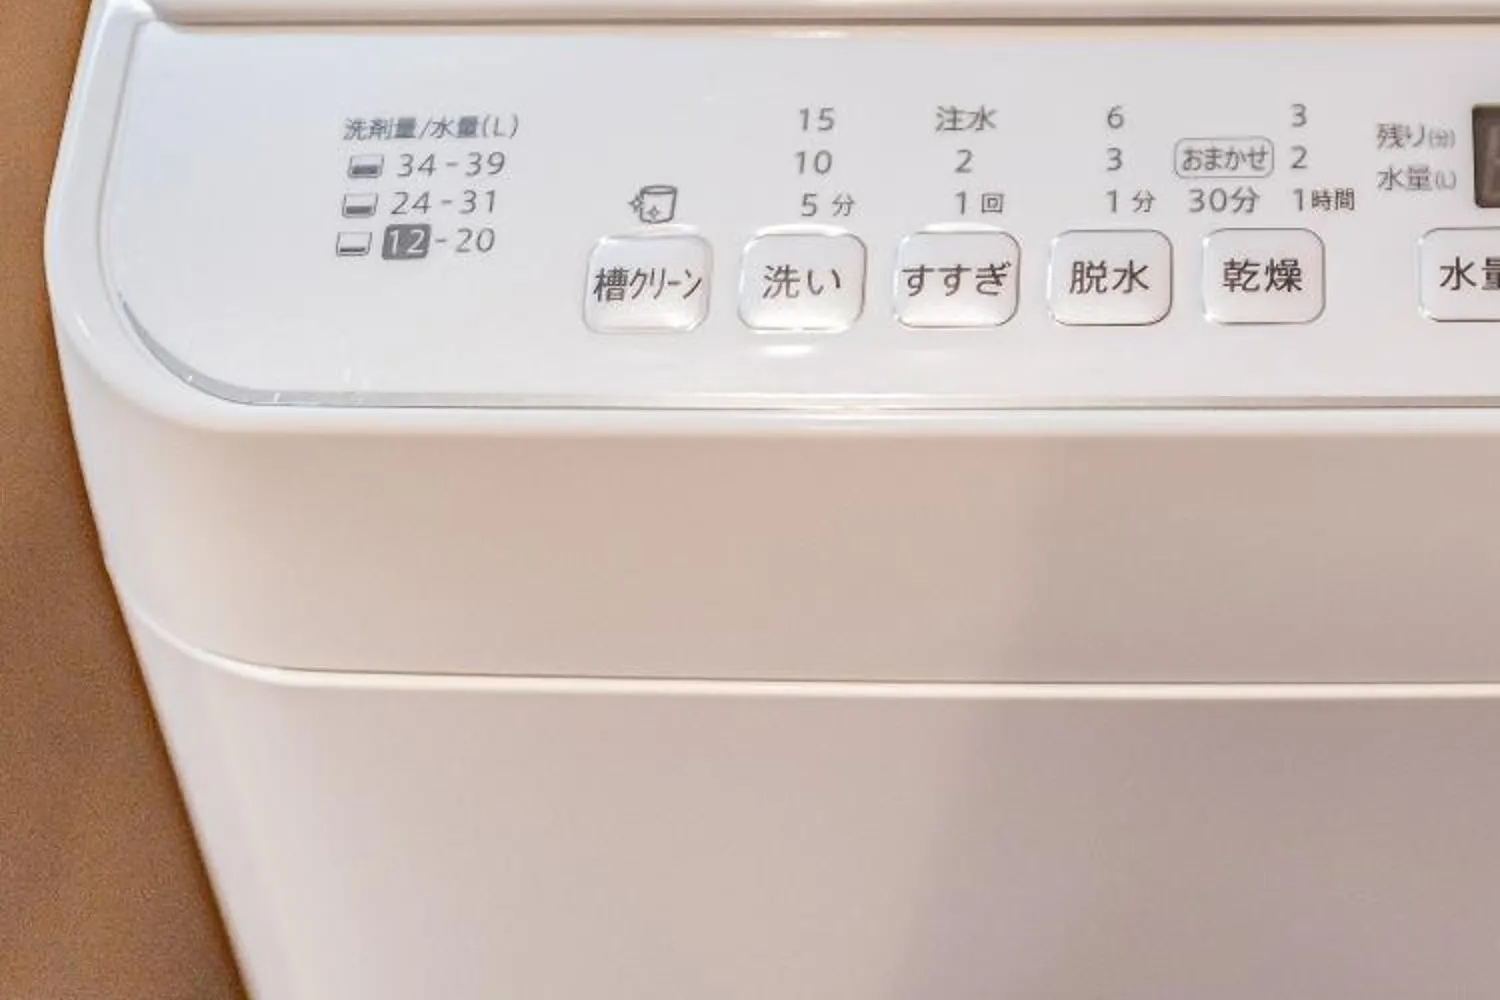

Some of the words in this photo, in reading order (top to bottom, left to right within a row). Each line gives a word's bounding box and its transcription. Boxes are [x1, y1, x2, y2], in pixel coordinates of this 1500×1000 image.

[343, 114, 519, 142] 洗剤量/水量(L)
[799, 107, 836, 132] 15
[935, 104, 997, 132] 注水
[1106, 105, 1125, 130] 6
[1291, 103, 1308, 129] 3
[795, 149, 833, 176] 10
[954, 148, 974, 174] 2
[1106, 146, 1124, 172] 3
[1181, 144, 1269, 172] おまかせ
[1290, 145, 1308, 170] 2
[1189, 186, 1261, 215] 30分
[592, 266, 703, 303] 槽クリーン
[762, 263, 842, 299] 洗い
[901, 260, 1013, 297] すすぎ
[1069, 258, 1150, 295] 脱水
[1222, 257, 1303, 293] 乾燥
